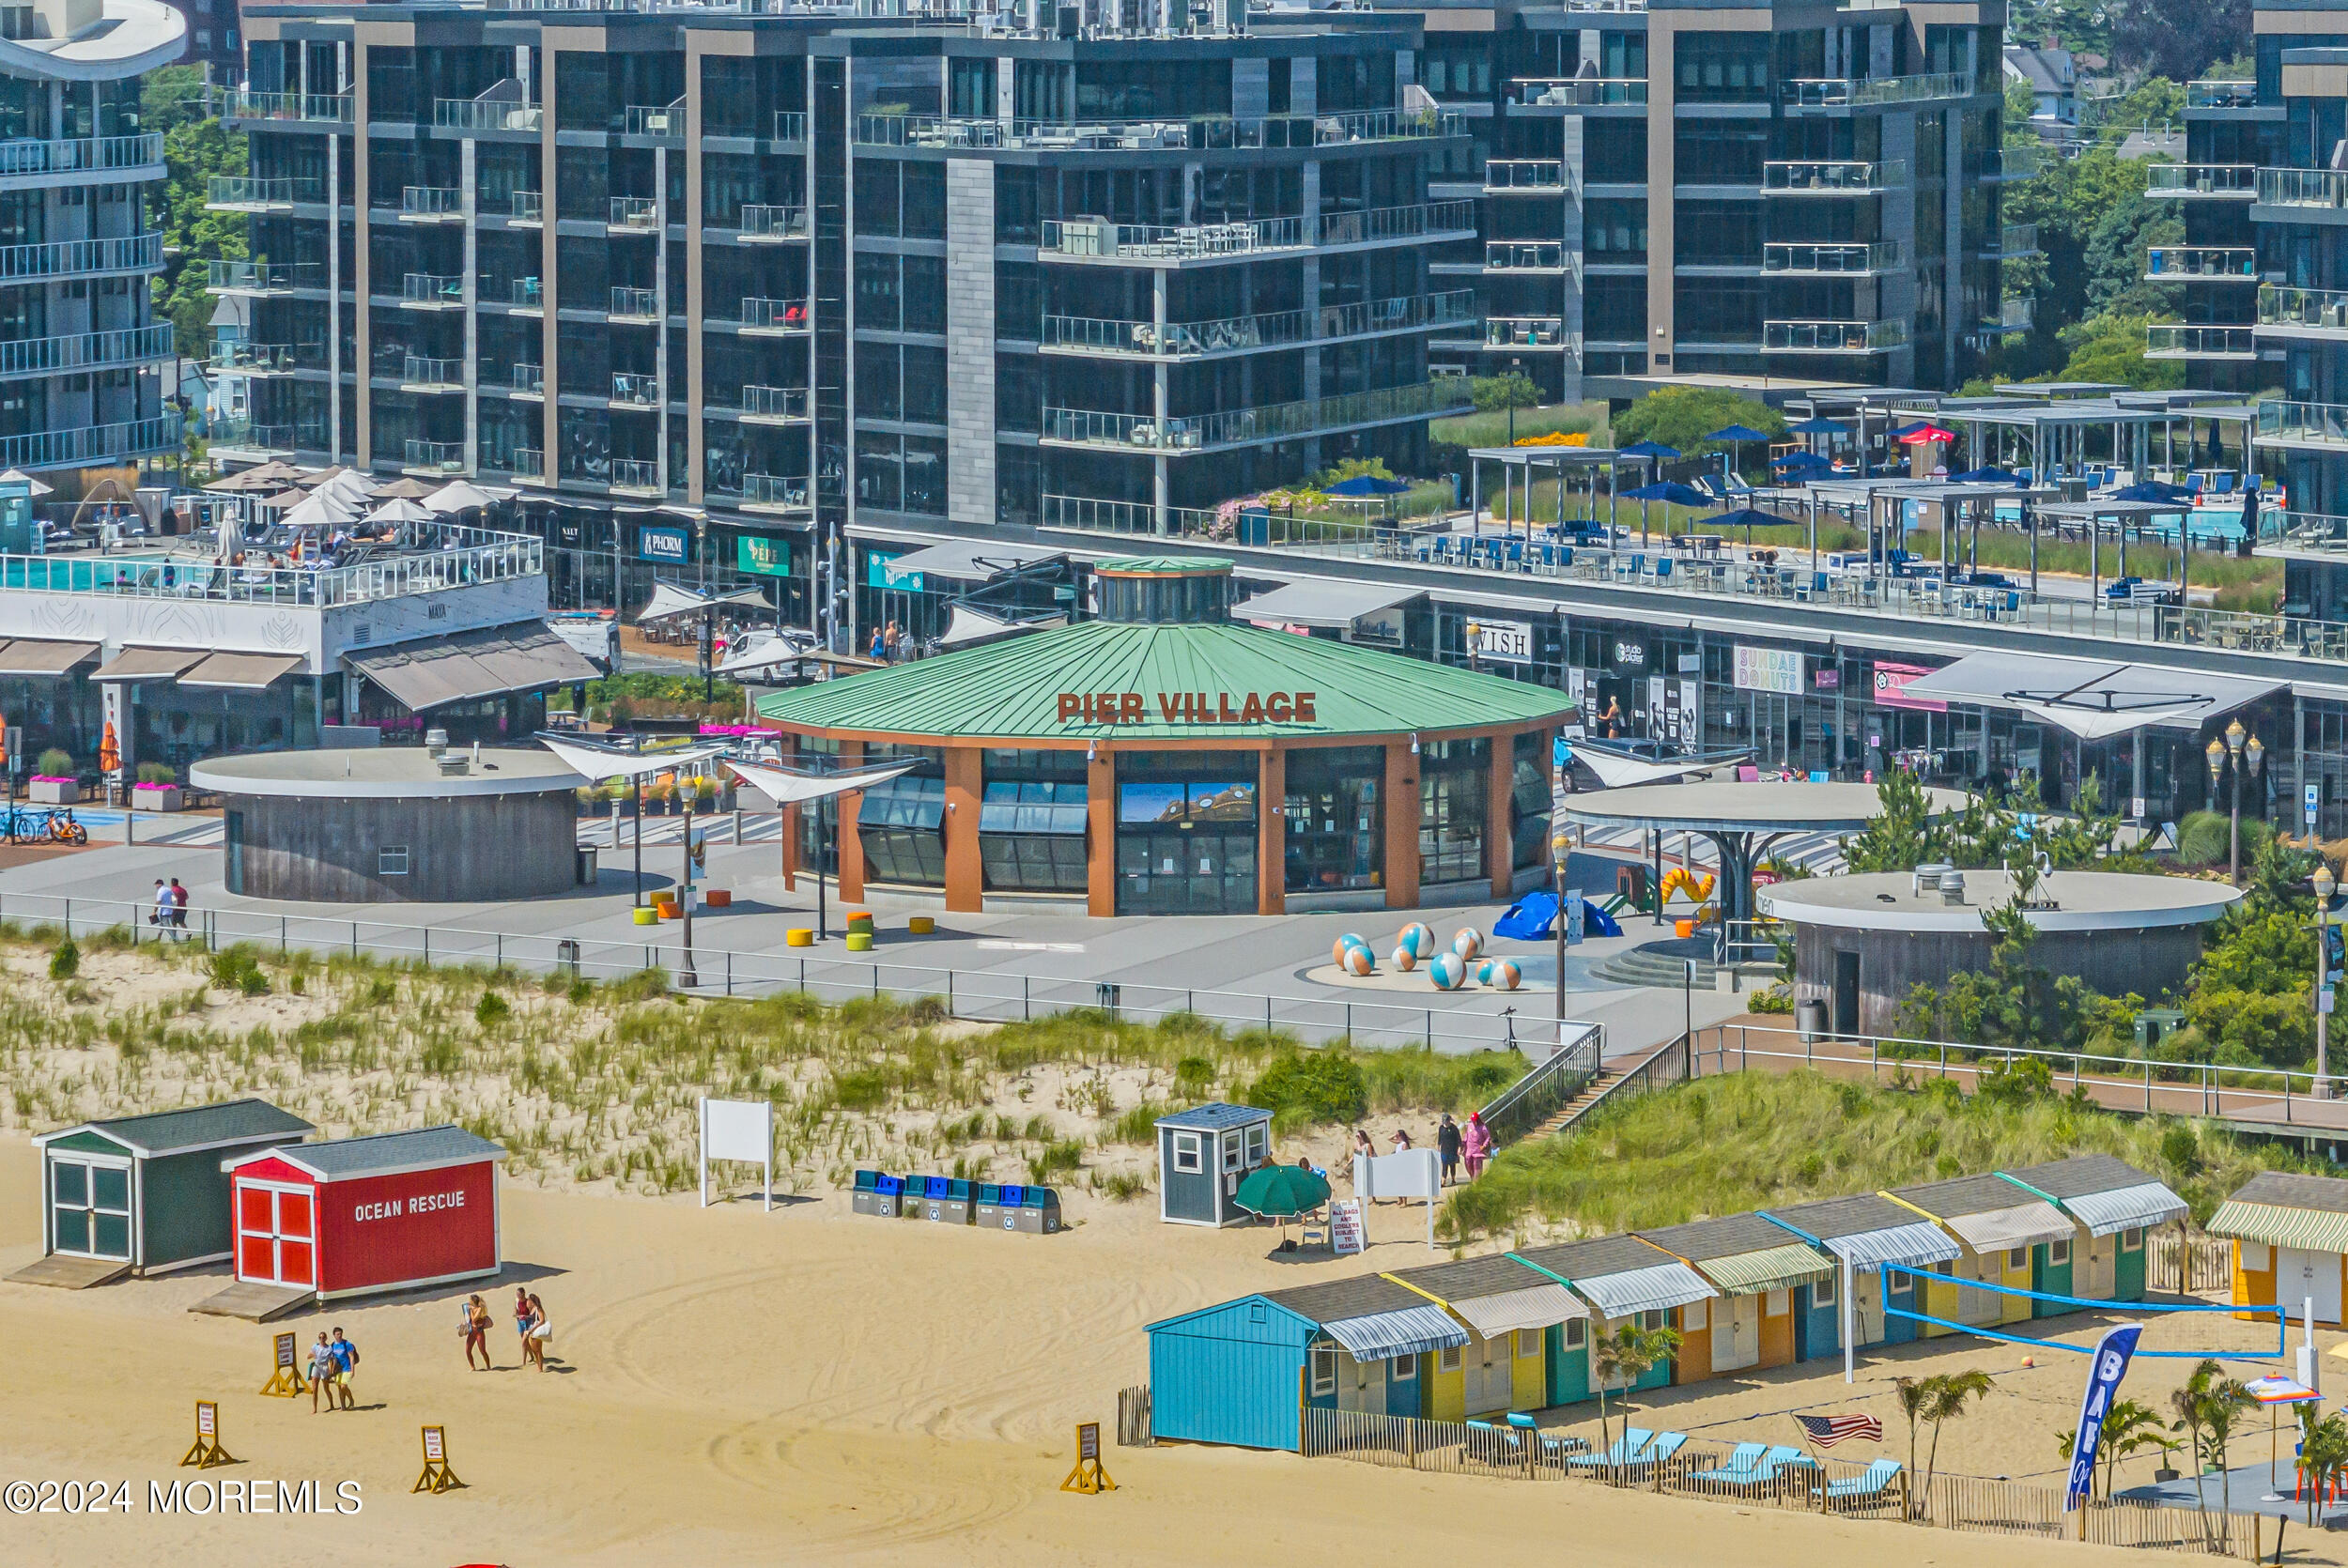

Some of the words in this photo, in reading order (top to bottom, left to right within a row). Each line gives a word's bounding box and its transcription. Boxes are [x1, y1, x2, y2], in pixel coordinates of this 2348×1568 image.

[653, 535, 683, 552] PHORM
[1739, 649, 1797, 671] SUNDAE
[1739, 668, 1797, 691] DONUTS
[1058, 693, 1144, 724] PIER
[1157, 691, 1316, 724] VILLAGE
[355, 1200, 402, 1222] OCEAN
[409, 1191, 465, 1214] RESCUE
